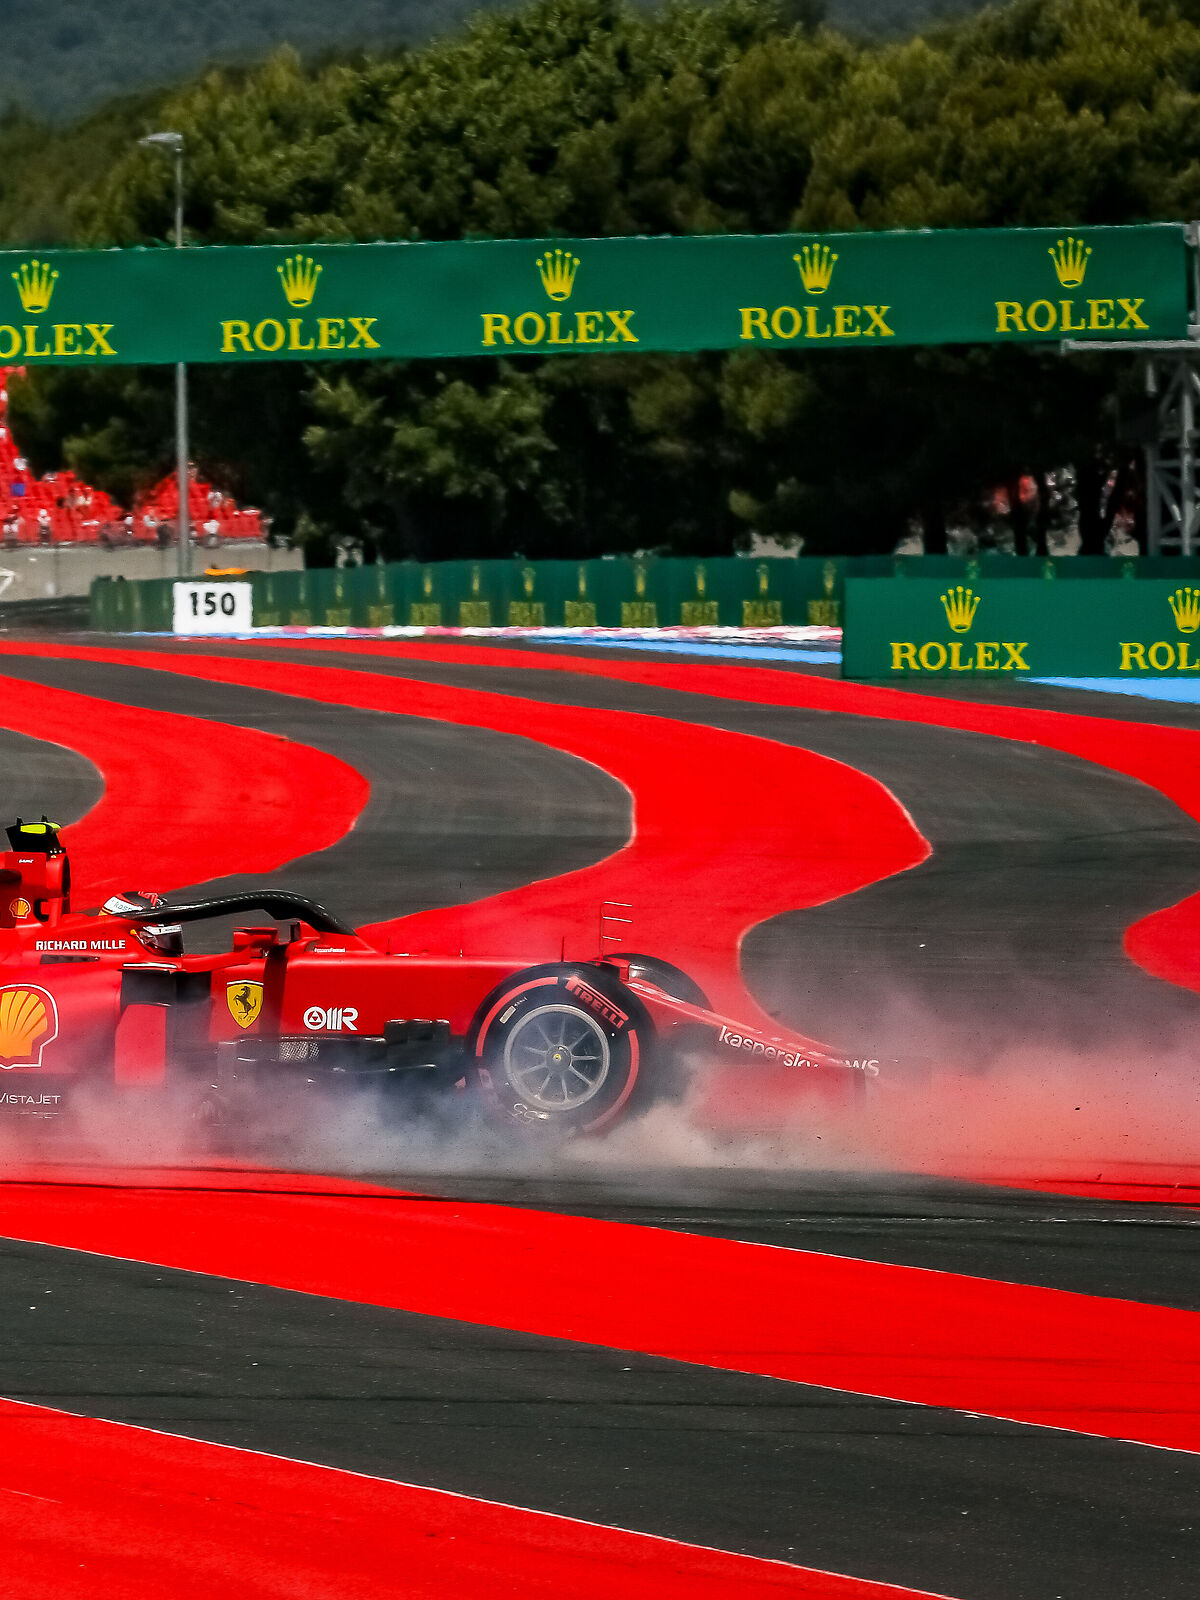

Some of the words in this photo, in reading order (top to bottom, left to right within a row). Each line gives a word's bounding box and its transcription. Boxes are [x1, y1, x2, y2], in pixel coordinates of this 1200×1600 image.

[481, 309, 639, 346] ROLEX
[739, 305, 894, 340] ROLEX
[995, 298, 1149, 333] ROLEX
[221, 317, 379, 353] ROLEX
[190, 592, 236, 617] 150
[890, 641, 1030, 671] ROLEX
[35, 940, 87, 951] RICHARD
[90, 939, 126, 950] MILLE
[303, 1006, 359, 1031] OMR
[564, 975, 630, 1029] PIRELLI
